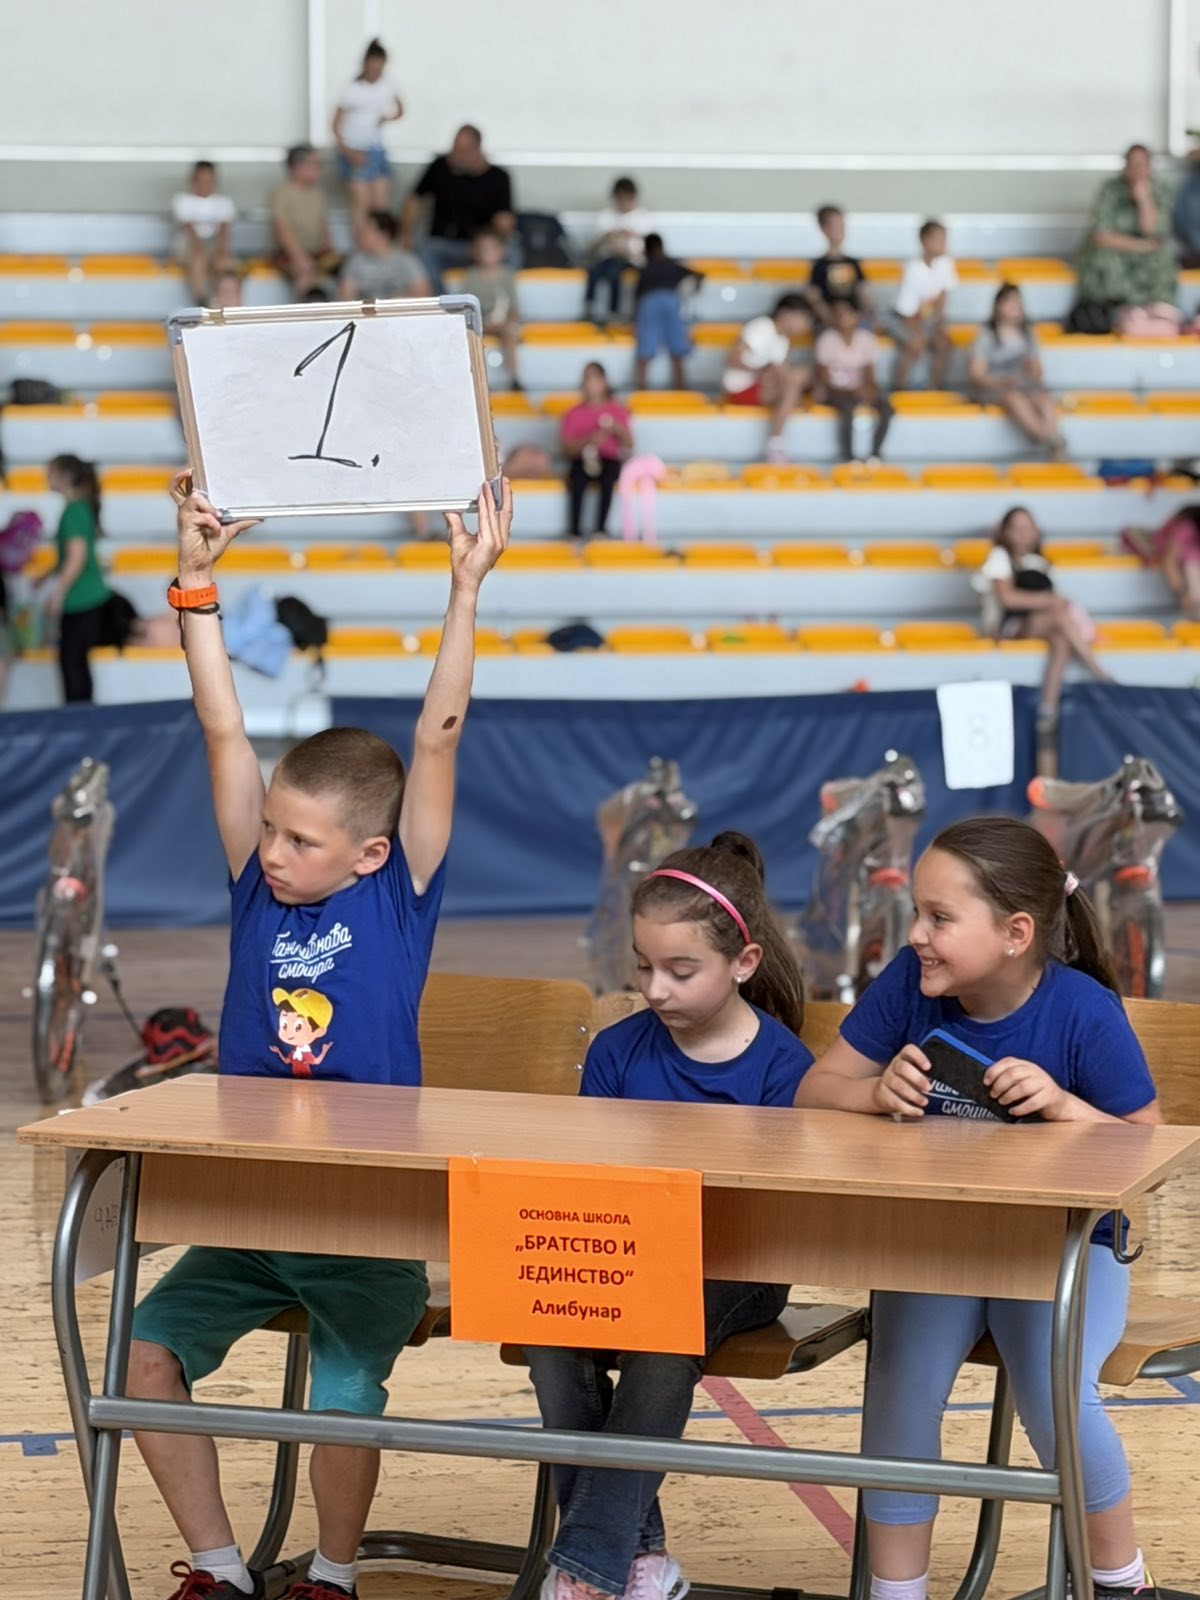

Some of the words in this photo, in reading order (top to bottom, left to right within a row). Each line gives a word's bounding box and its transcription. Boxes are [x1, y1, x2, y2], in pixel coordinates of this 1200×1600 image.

[288, 321, 380, 468] 1.
[519, 1208, 580, 1222] ОСНОВНА
[582, 1211, 631, 1226] ШКОЛА
[515, 1234, 617, 1255] „БРАТСТВО
[623, 1240, 636, 1256] И
[518, 1264, 634, 1286] ЈЕДИНСТВО“
[531, 1299, 622, 1322] Алибунар
